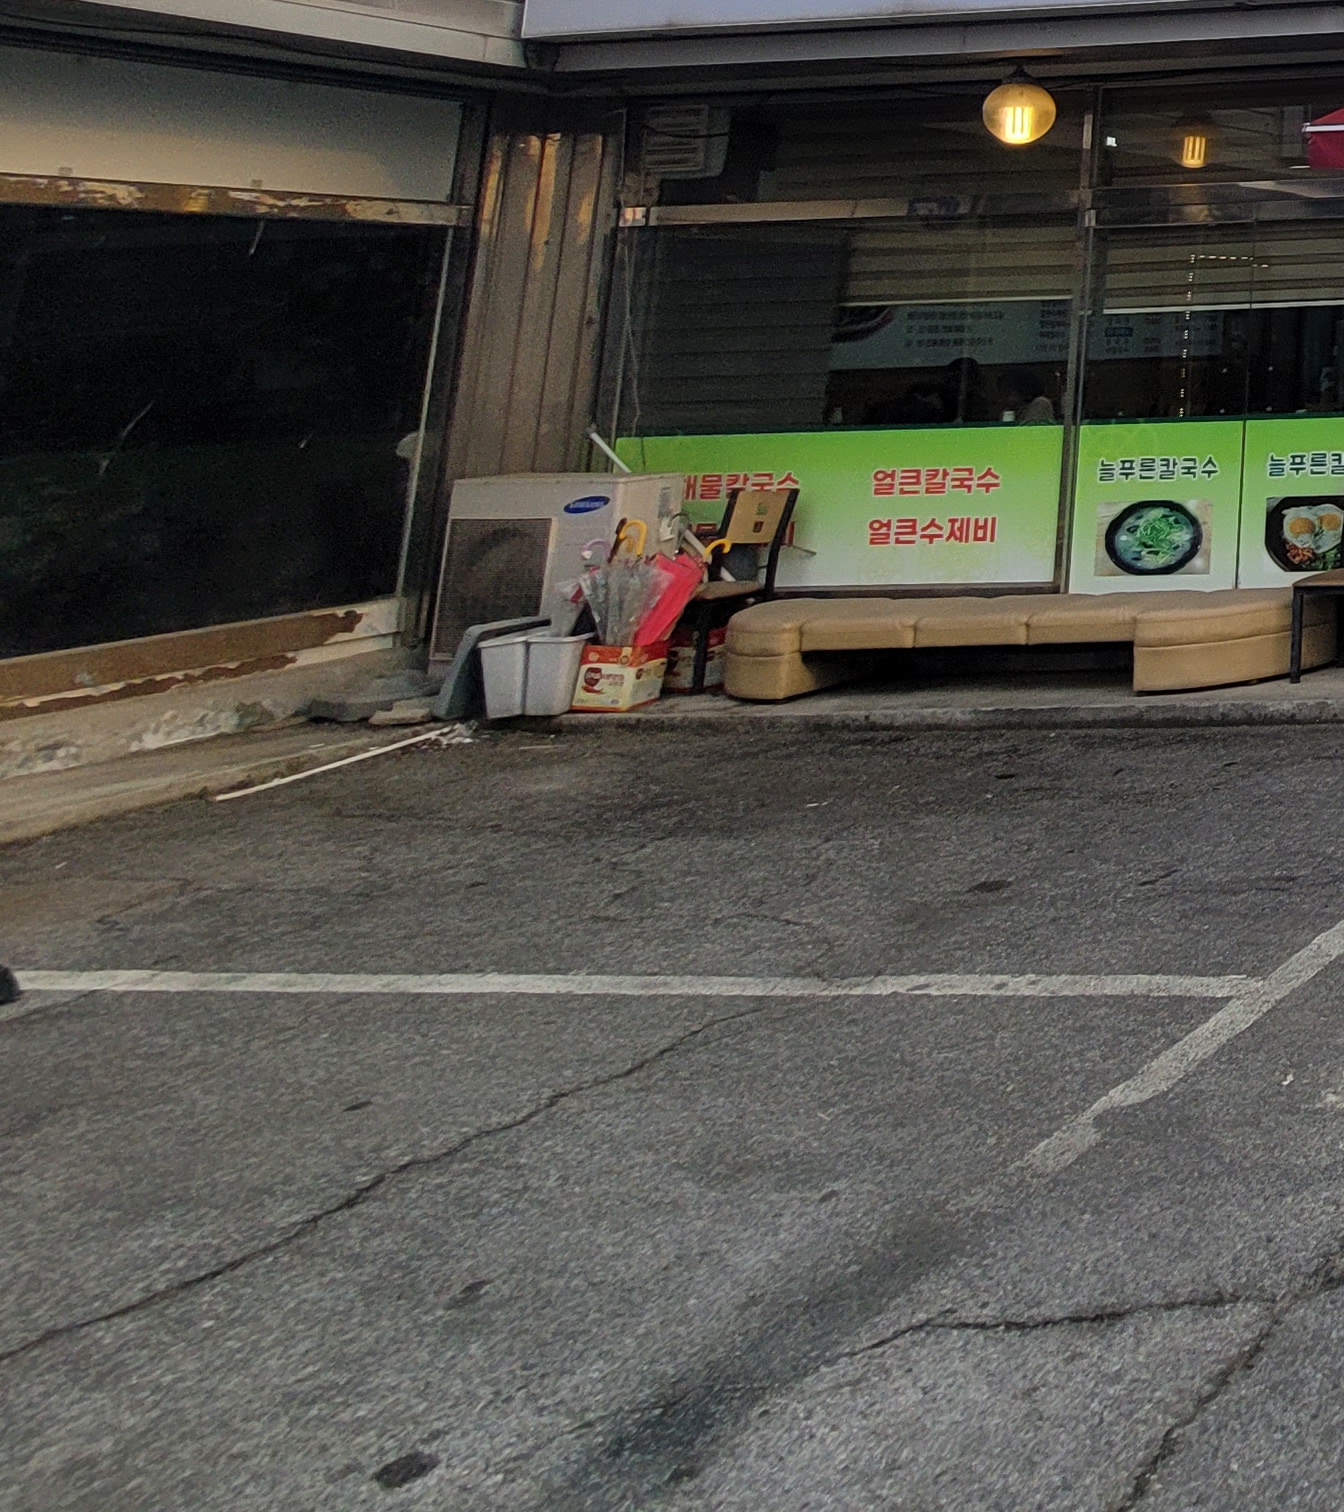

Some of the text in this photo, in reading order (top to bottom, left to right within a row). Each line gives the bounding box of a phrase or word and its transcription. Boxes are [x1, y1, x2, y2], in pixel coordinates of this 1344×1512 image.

[872, 465, 1002, 498] 얼큰칼국수
[1097, 454, 1220, 482] 늘푸른칼국수
[867, 514, 998, 547] 얼큰수제비
